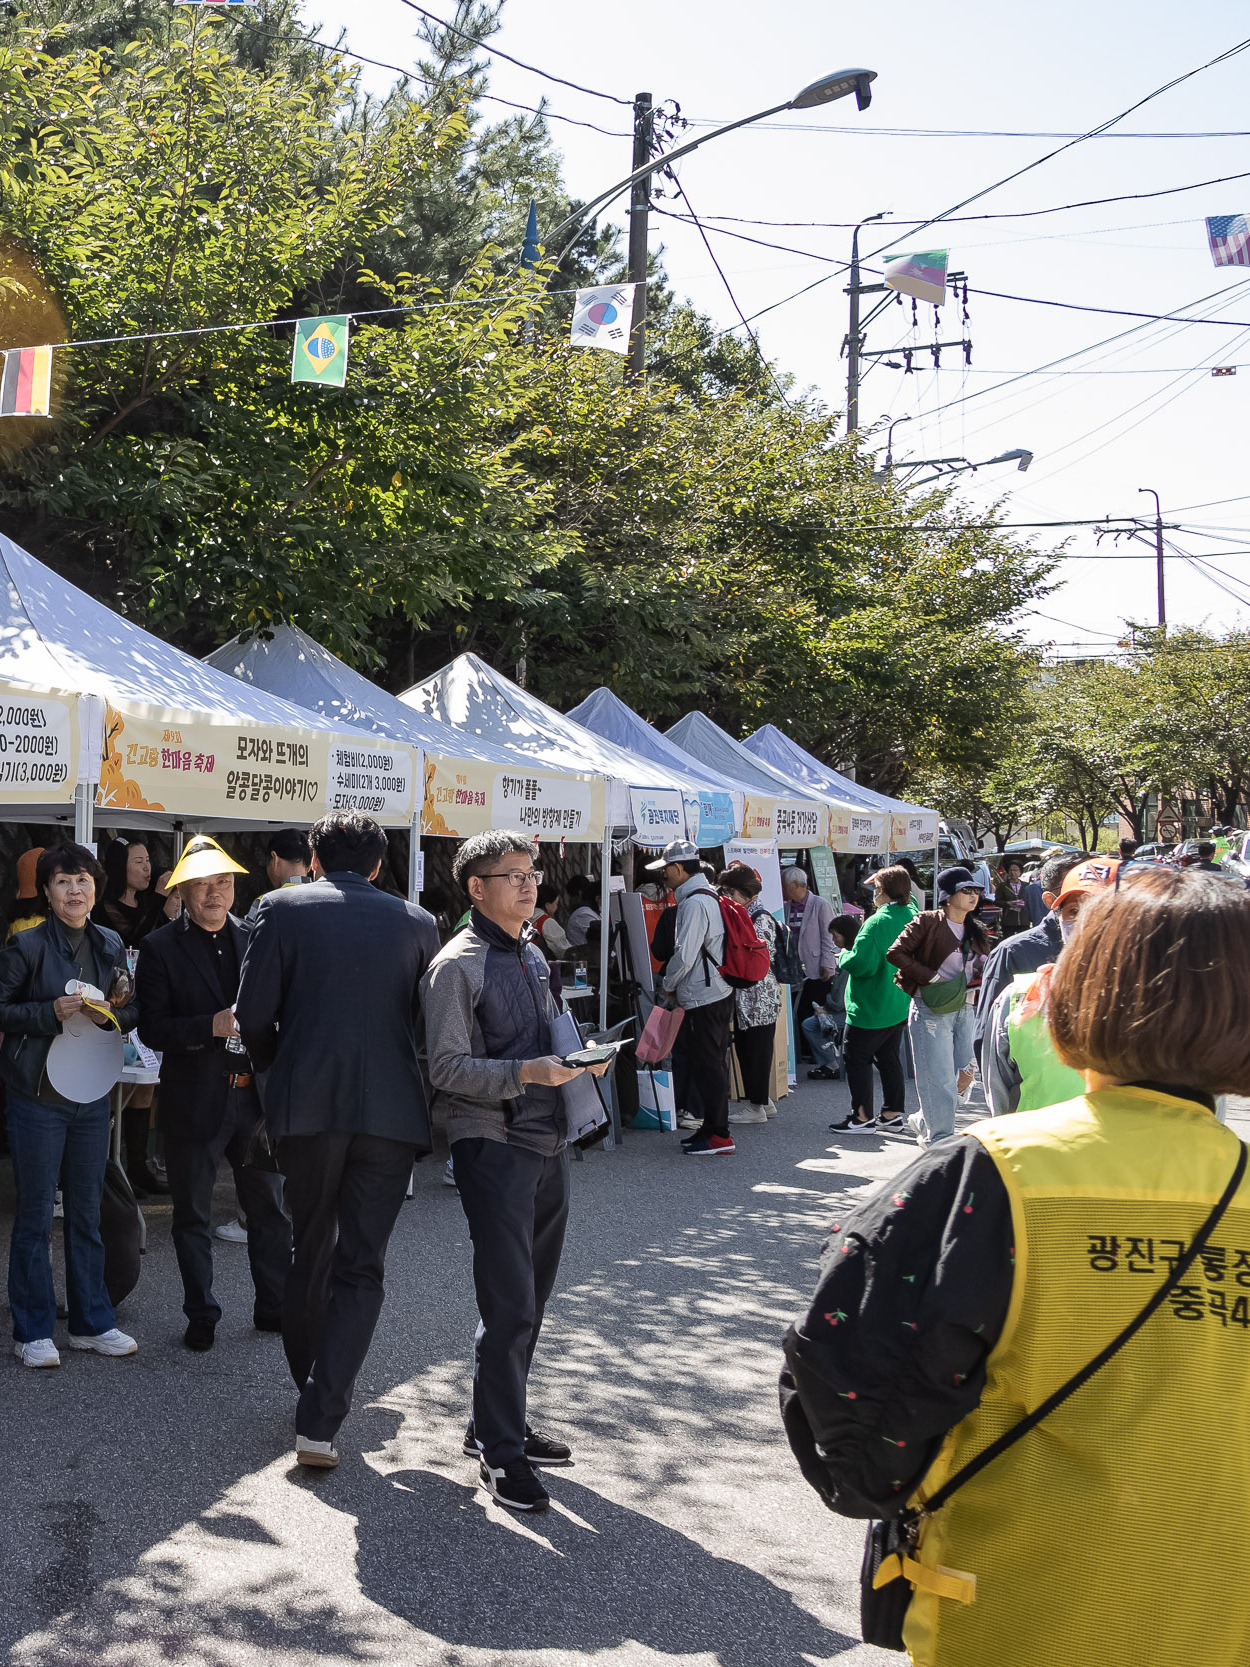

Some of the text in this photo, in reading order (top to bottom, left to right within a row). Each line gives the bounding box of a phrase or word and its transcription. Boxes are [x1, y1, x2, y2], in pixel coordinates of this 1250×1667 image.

[161, 729, 183, 744] 제9회
[126, 743, 215, 774] 긴고랑 한마음 축제
[236, 736, 309, 768] 모자와 뜨개의
[336, 749, 394, 771] 체험비(2,000원)
[226, 770, 308, 802] 알콩달콩이야기
[336, 773, 406, 793] 수세미(2개 3,000원)
[502, 775, 524, 799] 향기가
[520, 806, 582, 829] 나만의 방향제 만들기
[1086, 1235, 1187, 1276] 광진구
